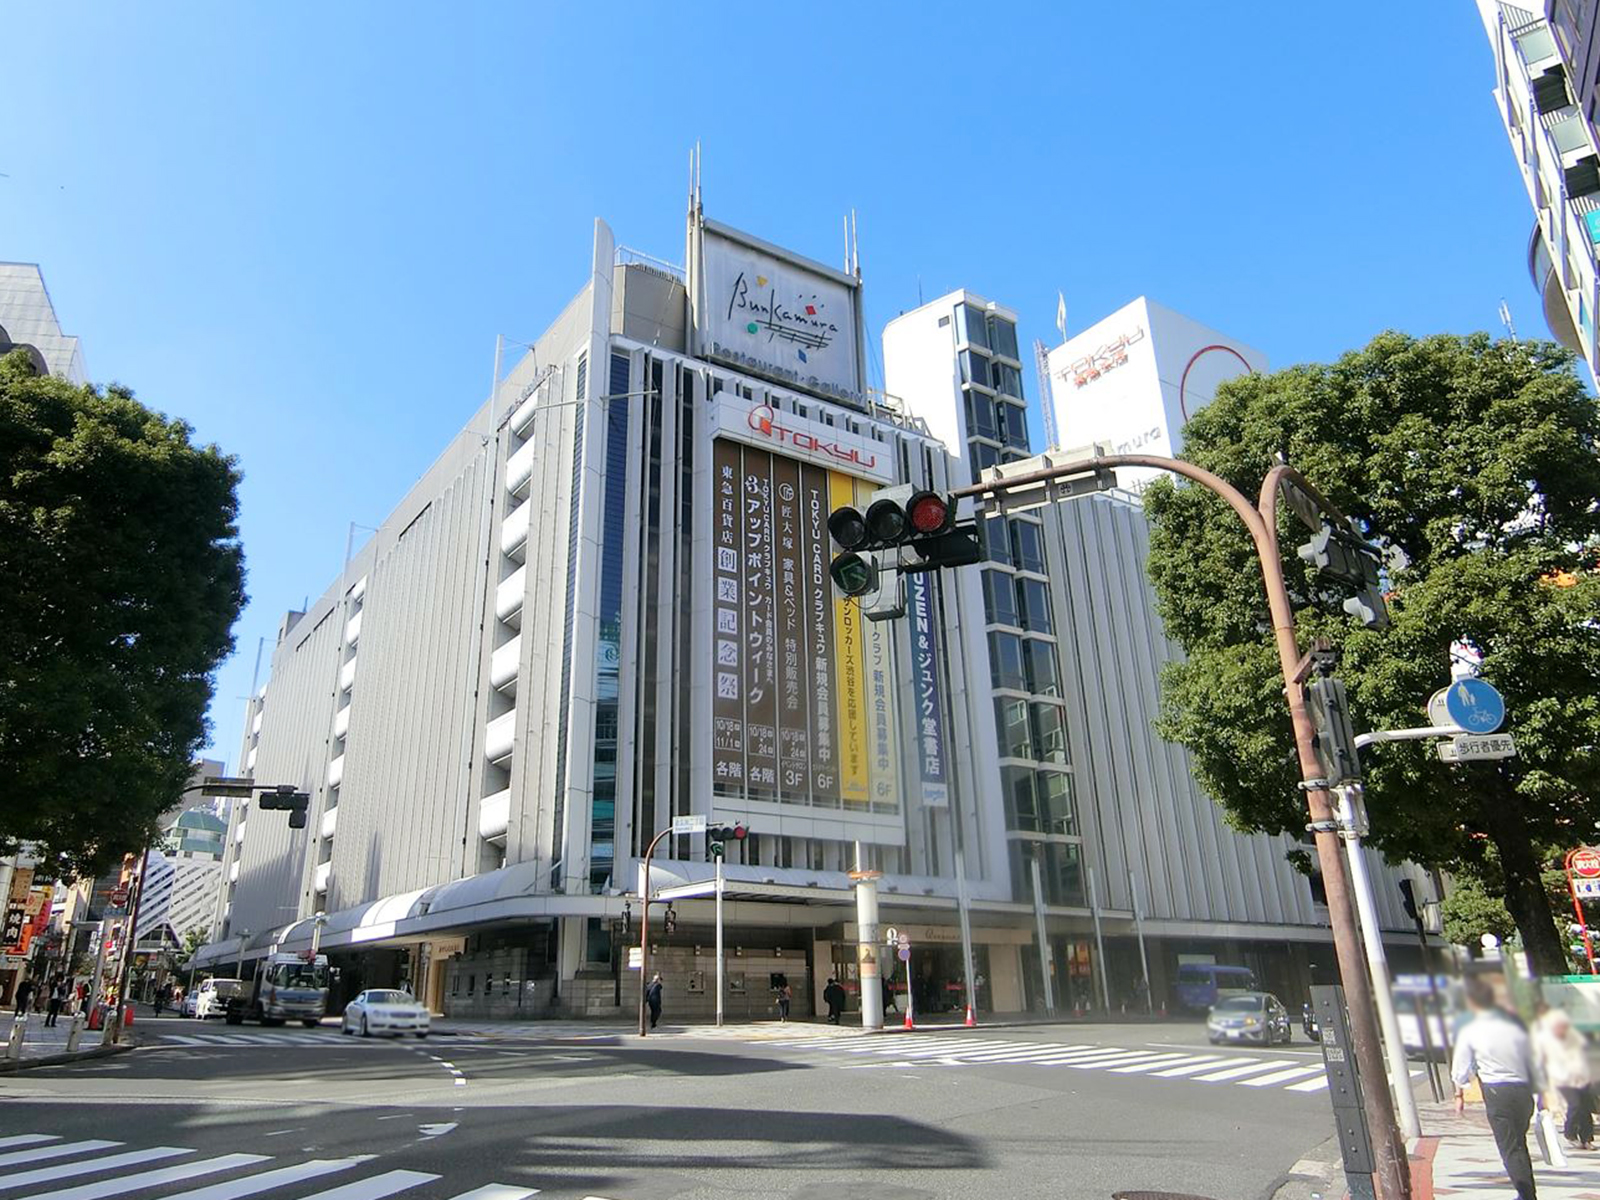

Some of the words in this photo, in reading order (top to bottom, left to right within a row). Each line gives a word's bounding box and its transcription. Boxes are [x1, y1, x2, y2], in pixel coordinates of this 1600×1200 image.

[727, 272, 839, 333] Bunkamura
[711, 342, 800, 379] Restaurant
[808, 375, 863, 403] Gallery
[1053, 325, 1145, 382] TOKYU
[771, 425, 876, 468] TOKYU
[781, 505, 794, 549] 匠大塚
[810, 489, 821, 540] TOKYU
[812, 543, 823, 585] CARD
[814, 588, 826, 655] クラブキュウ
[1458, 739, 1514, 756] 歩行者優先
[716, 760, 742, 778] 各階
[749, 766, 775, 784] 各階
[785, 769, 803, 787] 3F
[817, 773, 834, 790] 6F
[876, 781, 892, 798] 6F
